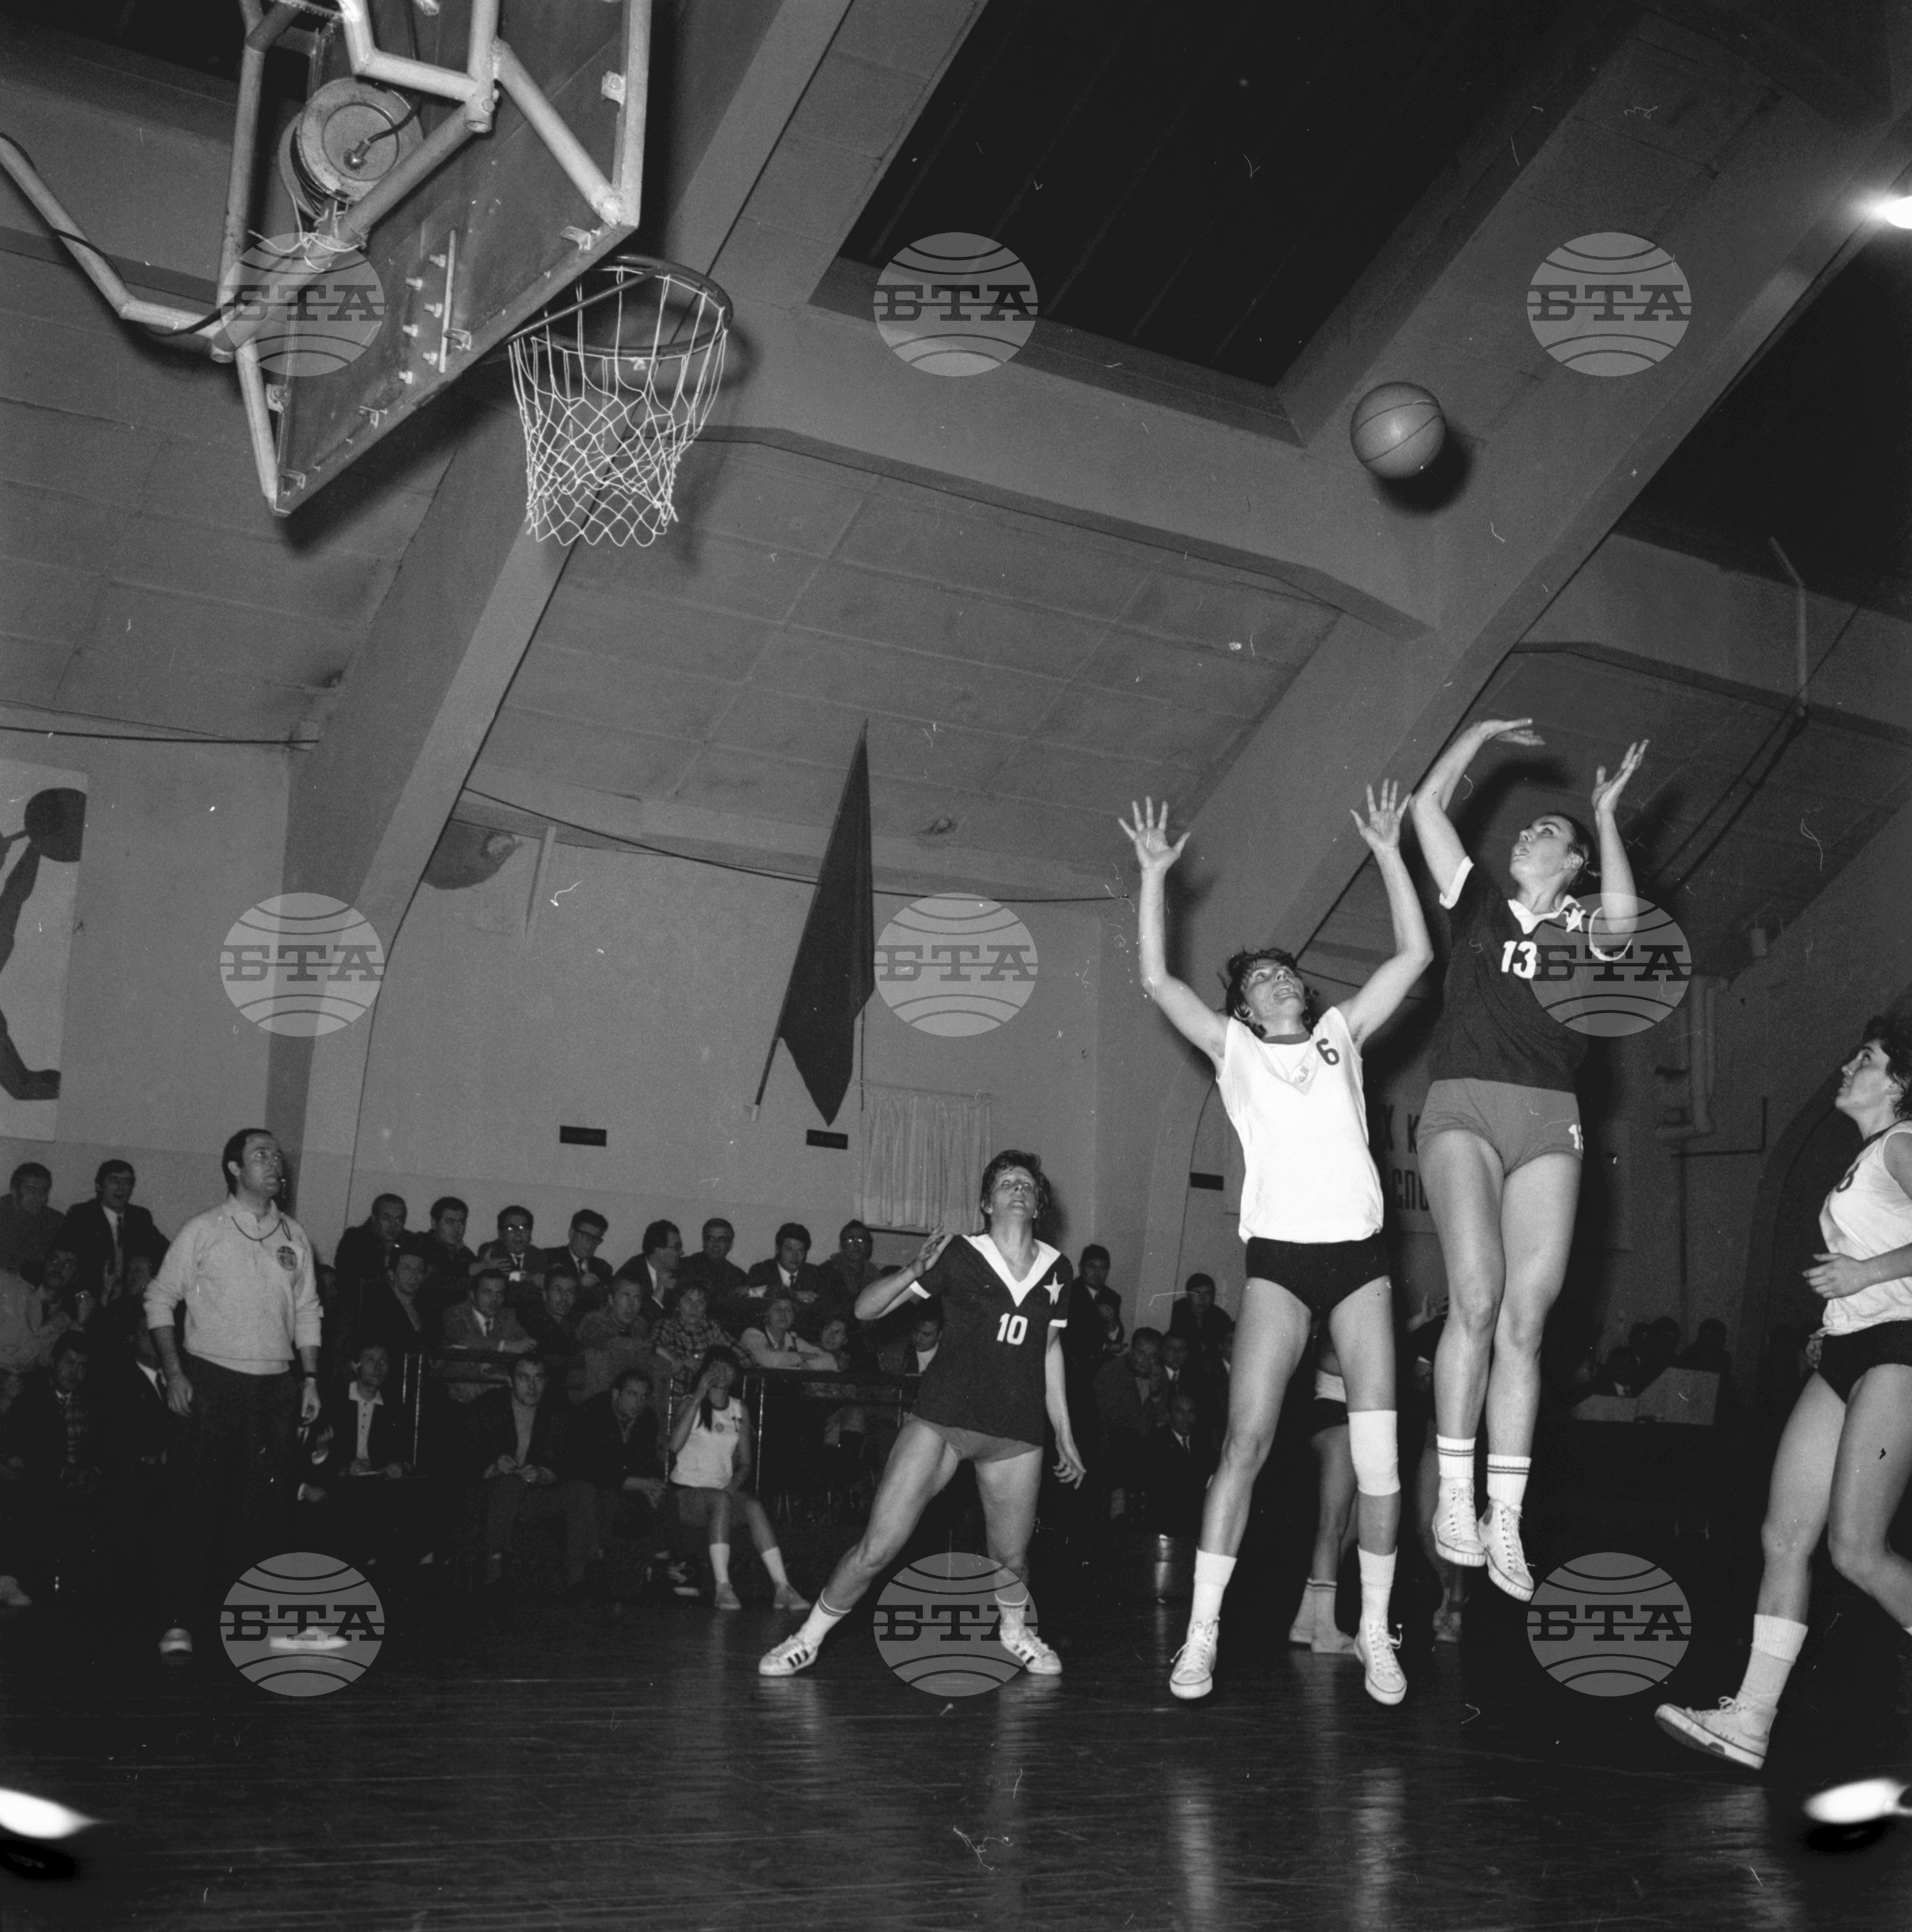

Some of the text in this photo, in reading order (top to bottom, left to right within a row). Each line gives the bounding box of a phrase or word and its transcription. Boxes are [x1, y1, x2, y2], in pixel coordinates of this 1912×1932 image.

[1501, 940, 1538, 979] 13
[1316, 1038, 1340, 1066] 6
[996, 1313, 1029, 1346] 10
